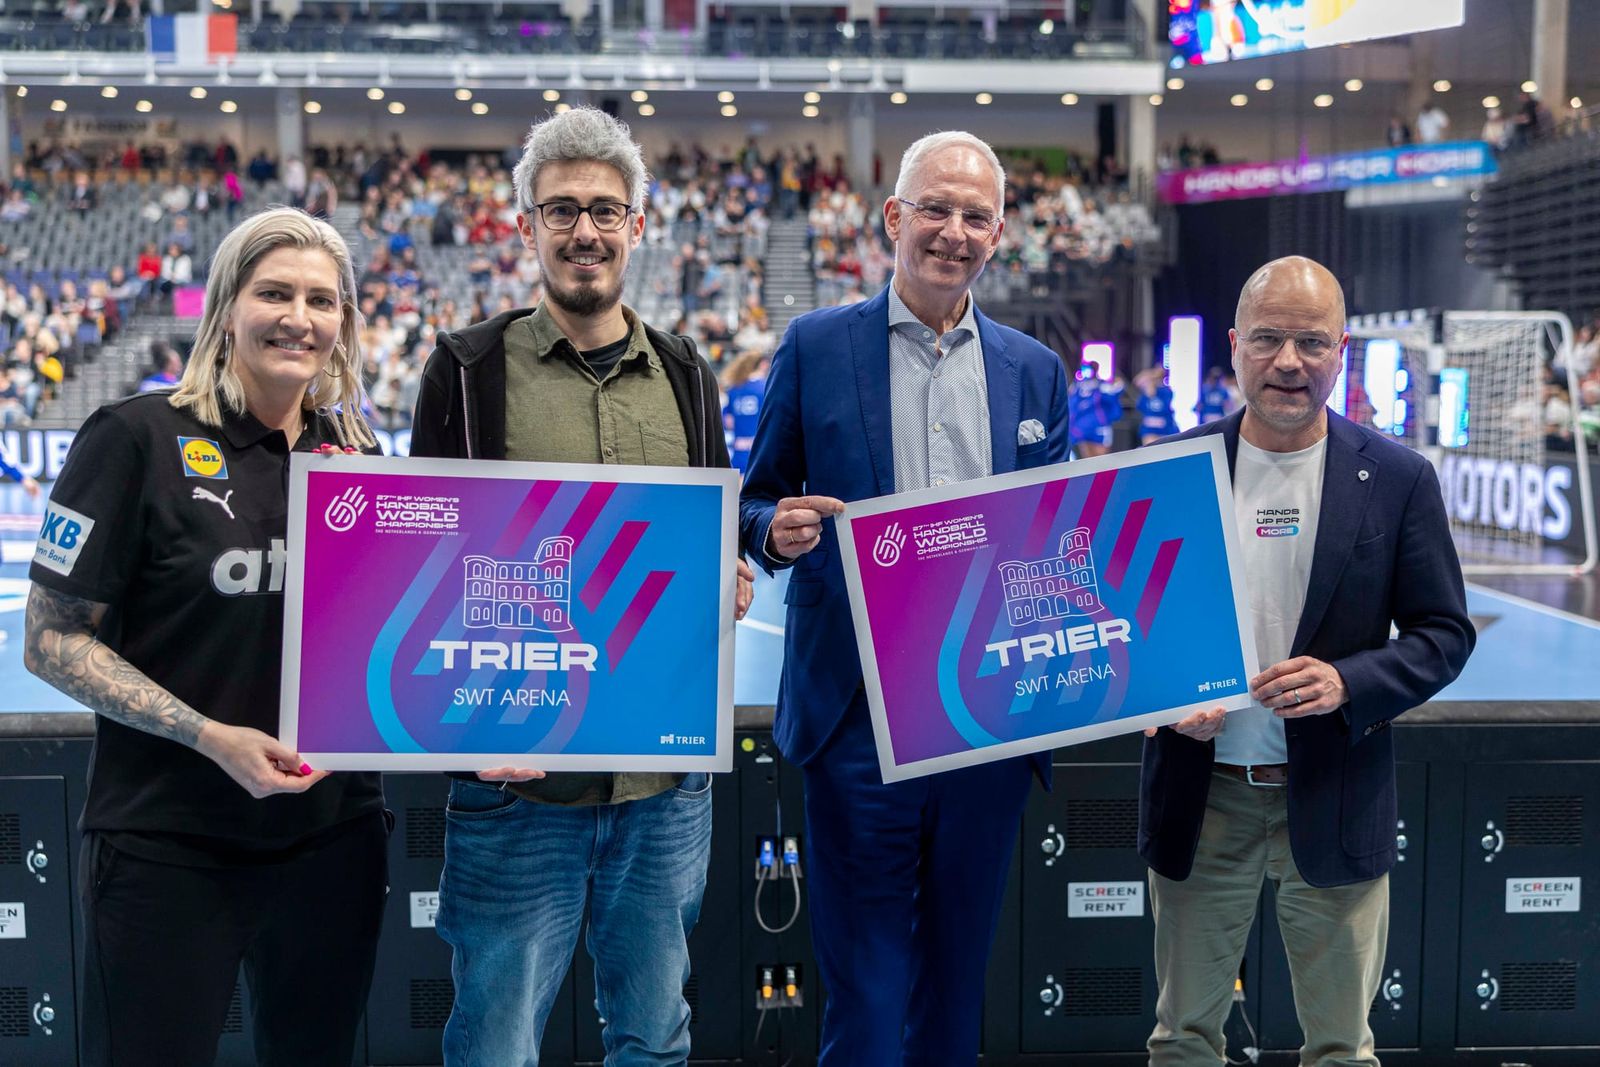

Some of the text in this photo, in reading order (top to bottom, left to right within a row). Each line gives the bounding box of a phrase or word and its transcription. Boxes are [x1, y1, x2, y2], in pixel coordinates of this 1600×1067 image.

[376, 501, 459, 511] HANDBALL
[376, 510, 459, 522] WORLD
[1256, 508, 1300, 516] HANDS
[375, 521, 459, 529] CHAMPIONSHIP
[1275, 517, 1300, 525] FOR
[912, 520, 985, 539] HANDBALL
[1260, 527, 1295, 536] MORE
[914, 527, 987, 549] WORLD
[916, 536, 988, 556] CHAMPIONSHIP
[48, 548, 67, 565] Bank
[985, 618, 1132, 668] TRIER
[430, 640, 598, 672] TRIER
[1014, 663, 1117, 697] SWT ARENA
[1210, 678, 1238, 690] TRIER
[453, 688, 571, 707] SWT ARENA
[675, 736, 706, 745] TRIER
[1074, 886, 1137, 897] SCREEN
[1512, 882, 1573, 893] SCREEN
[1084, 902, 1126, 913] RENT
[1522, 897, 1563, 908] RENT
